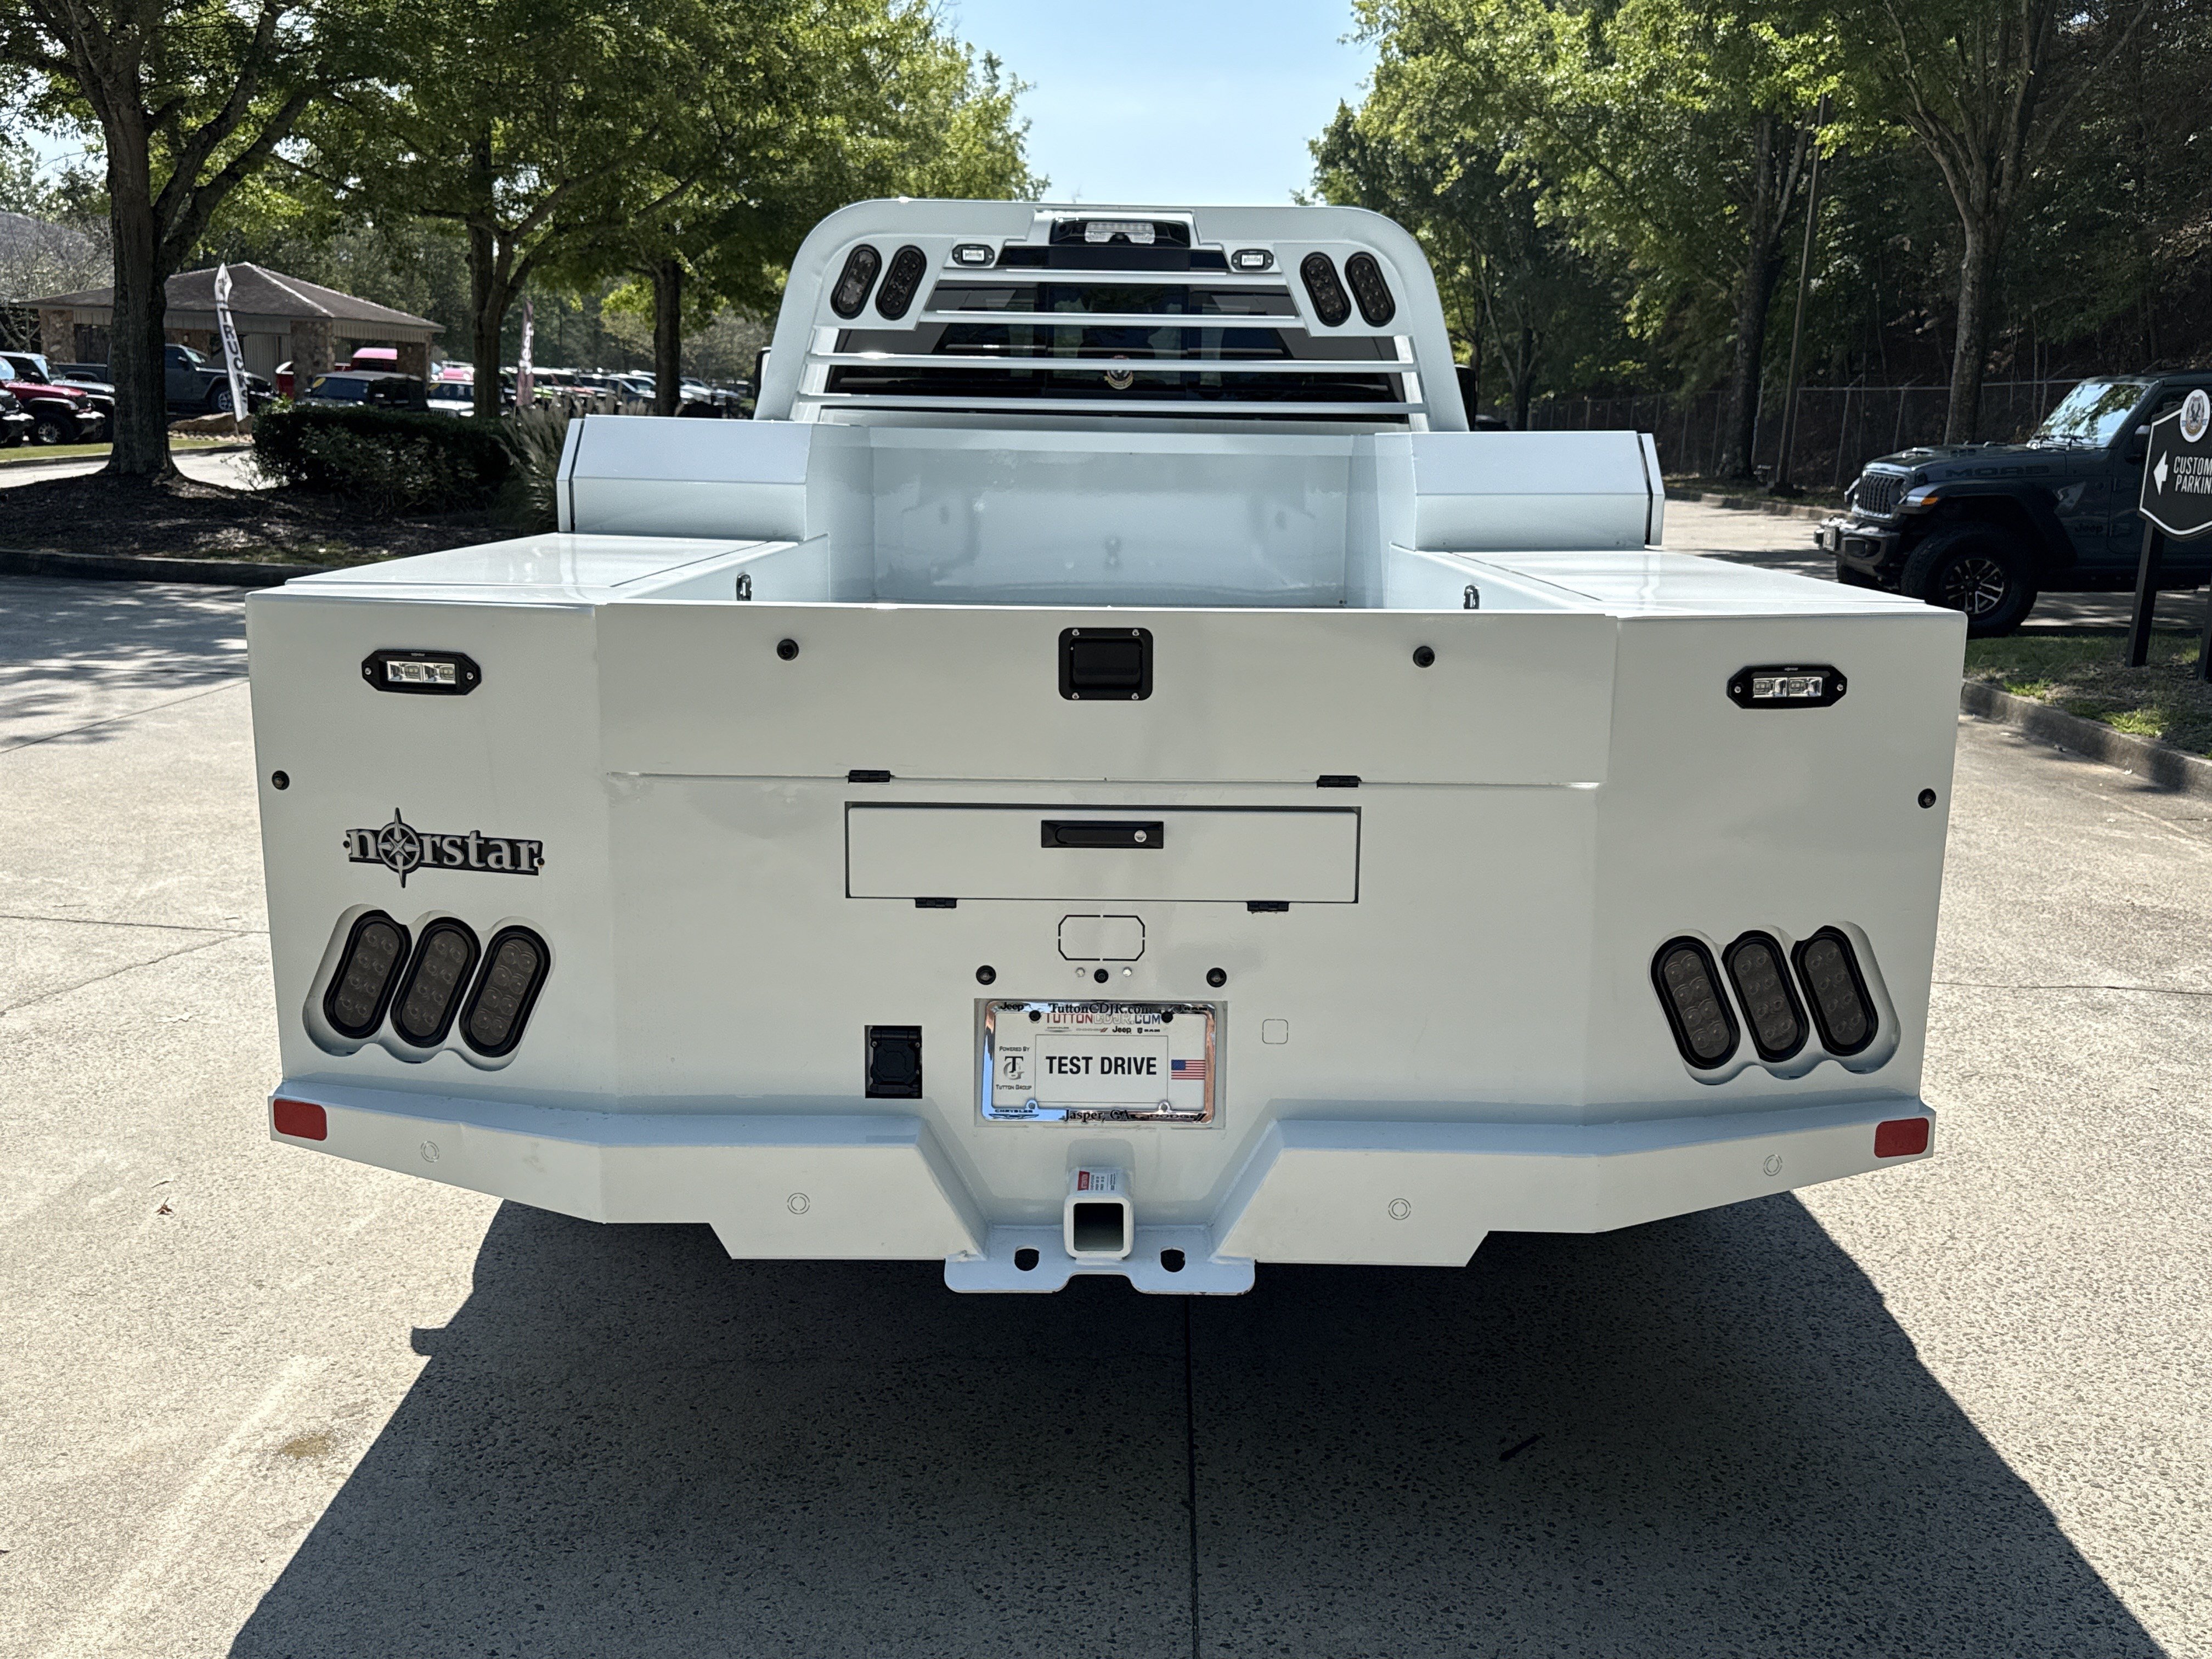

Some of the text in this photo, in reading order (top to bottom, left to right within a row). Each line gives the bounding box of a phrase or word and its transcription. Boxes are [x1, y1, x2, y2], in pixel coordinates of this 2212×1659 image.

[2175, 475, 2212, 494] PARKIN
[1000, 1002, 1025, 1012] Jeep
[1048, 1002, 1152, 1016] TuttonCDJR.com
[1047, 1013, 1160, 1025] TUTTONCDJR.COM
[1112, 1025, 1132, 1034] Jeep
[1046, 1056, 1156, 1075] TEST DRIVE
[1064, 1109, 1132, 1123] Jasper, GA
